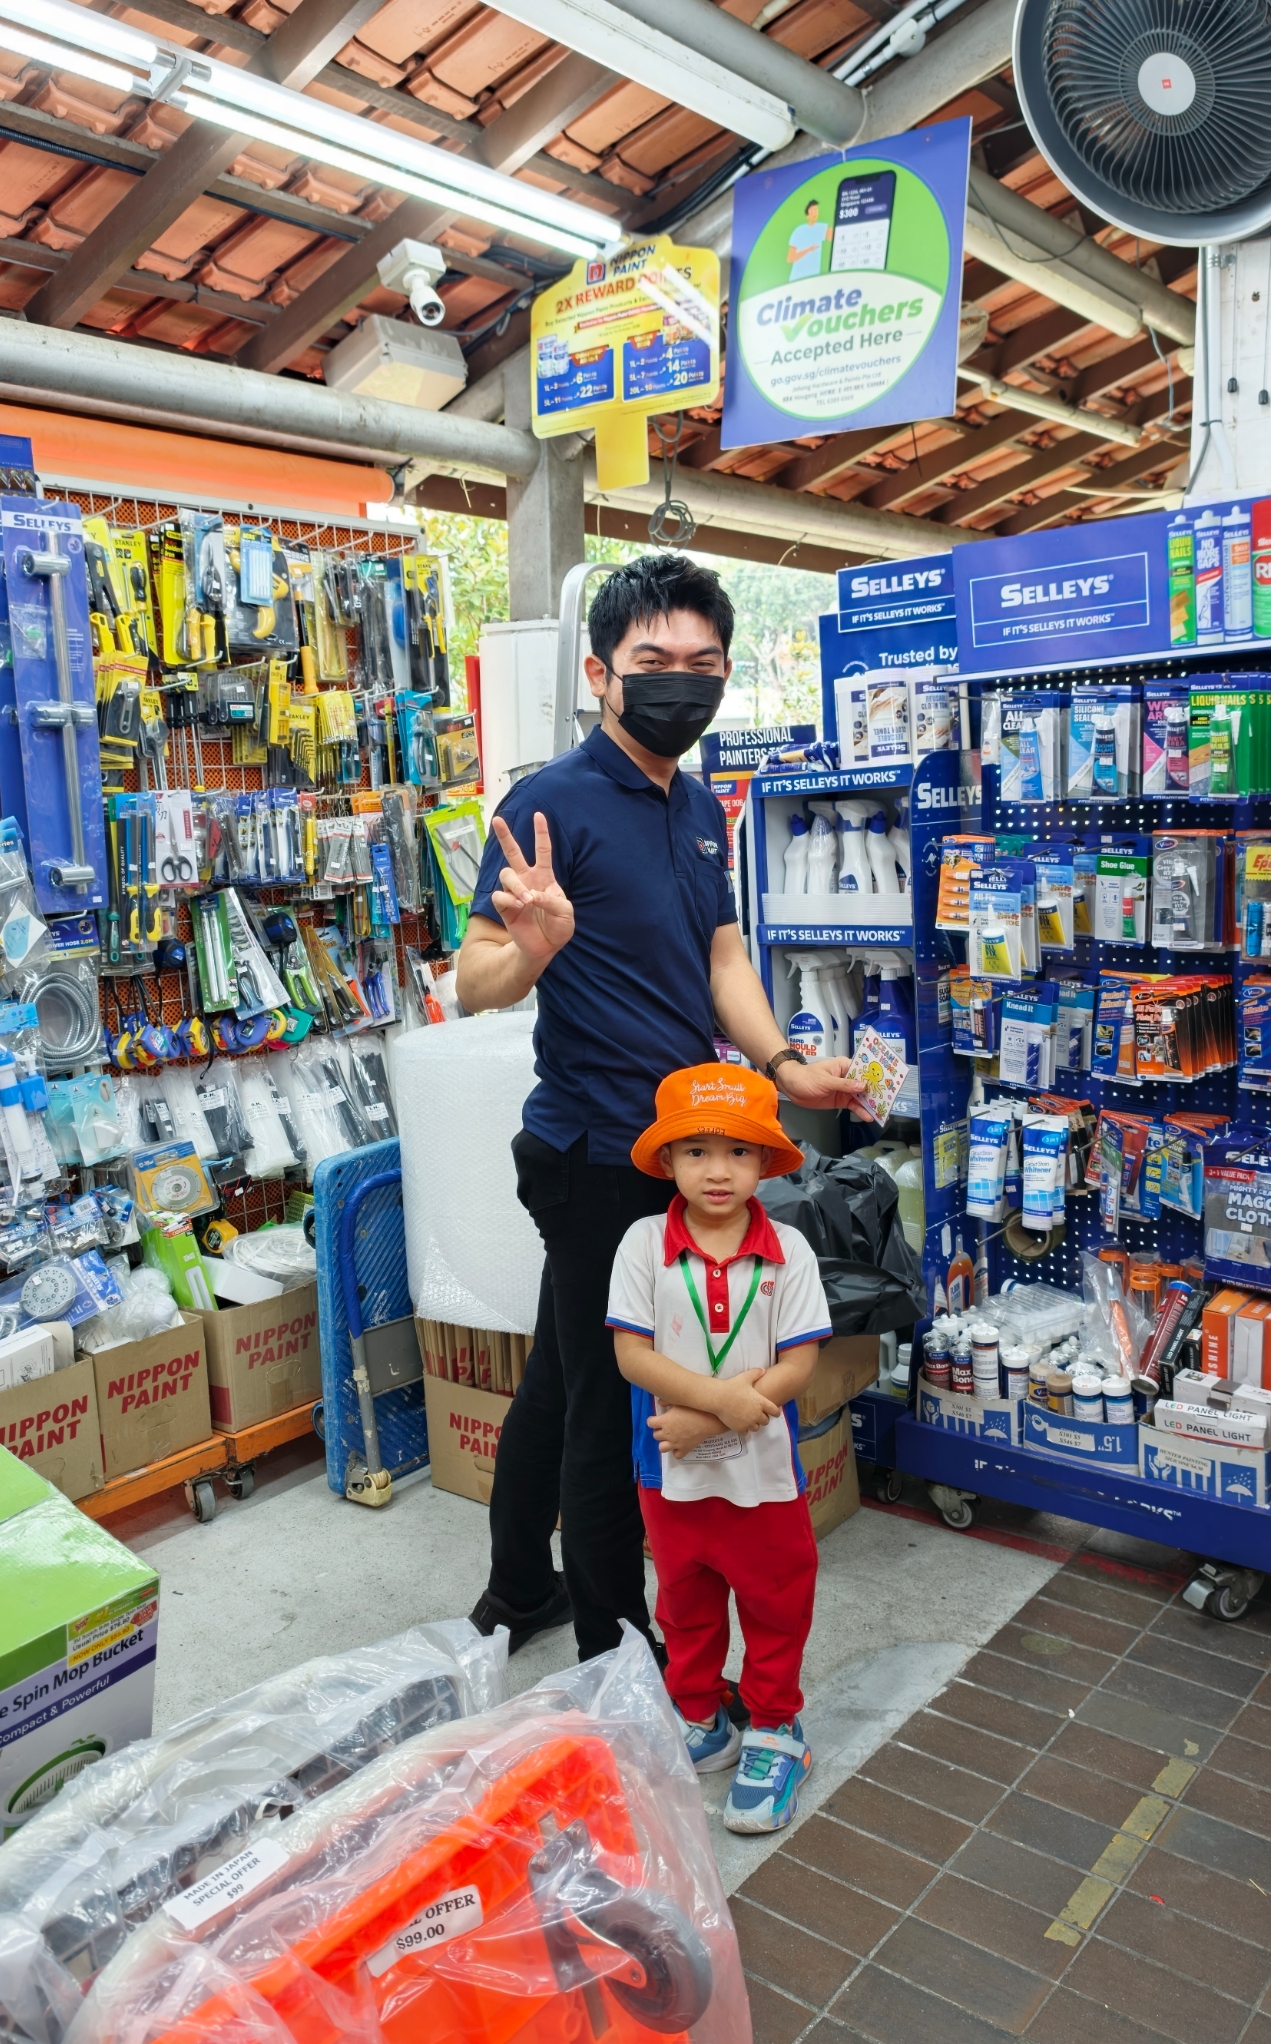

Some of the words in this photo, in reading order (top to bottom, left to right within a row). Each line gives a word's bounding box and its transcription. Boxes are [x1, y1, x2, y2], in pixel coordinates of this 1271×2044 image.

[839, 207, 858, 219] $300
[610, 245, 655, 267] NIPPON
[613, 260, 647, 277] PAINT
[556, 299, 572, 314] 2X
[576, 278, 635, 304] REWARD
[757, 289, 862, 326] Climate
[771, 335, 853, 365] Accepted
[860, 330, 903, 348] Here
[667, 360, 680, 372] 14
[770, 355, 901, 387] go.gov.sg/climatevouchers
[576, 373, 583, 384] 6
[673, 373, 688, 385] 20
[580, 385, 594, 398] 22
[14, 514, 71, 531] SELLEYS
[1170, 536, 1191, 547] LIQUID
[1196, 529, 1220, 538] SELLEYS
[1223, 529, 1249, 539] SELLEYS
[1170, 547, 1192, 559] NAILS
[1201, 538, 1215, 549] NO
[1196, 548, 1220, 560] MORE
[1197, 558, 1220, 570] GAPS
[851, 569, 942, 598] SELLEYS
[1001, 575, 1110, 608] SELLEYS
[852, 615, 859, 624] IF
[860, 613, 873, 622] IT'S
[874, 609, 904, 621] SELLEYS
[905, 608, 912, 617] IT
[913, 603, 942, 616] WORKS
[1003, 627, 1011, 637] IF
[1012, 625, 1028, 636] IT'S
[1029, 619, 1065, 633] SELLEYS
[1066, 618, 1076, 628] IT
[1077, 613, 1111, 627] WORKS
[879, 646, 935, 666] Trusted
[939, 645, 958, 660] by
[720, 726, 794, 747] PROFESSIONAL
[762, 782, 771, 793] IF
[773, 780, 792, 792] IT'S
[794, 776, 838, 790] SELLEYS
[840, 775, 850, 786] IT
[851, 771, 896, 786] WORKS
[917, 782, 982, 809] SELLEYS
[1101, 861, 1117, 870] Shoe
[1119, 862, 1135, 870] Glue
[974, 882, 1007, 890] SELLEYS
[768, 930, 777, 940] IF
[779, 930, 797, 940] IT'S
[798, 929, 843, 941] SELLEYS
[845, 930, 854, 941] IT
[854, 930, 900, 941] WORKS
[1006, 1002, 1025, 1012] Knead
[790, 1043, 817, 1052] MOULD
[873, 1037, 899, 1067] OCEANS
[690, 1080, 716, 1095] Start
[717, 1078, 745, 1092] Small
[691, 1094, 725, 1107] Dream
[726, 1093, 747, 1107] Big
[970, 1134, 998, 1144] SELLEYS
[1024, 1144, 1056, 1154] SELLEYS
[1220, 1170, 1235, 1178] VALUE
[1236, 1172, 1250, 1180] PACK
[1229, 1185, 1257, 1194] MIGHTY
[236, 1311, 316, 1355] NIPPON
[248, 1332, 311, 1369] PAINT
[107, 1350, 199, 1399] NIPPON
[952, 1367, 971, 1376] Max
[121, 1372, 193, 1414] PAINT
[1165, 1402, 1183, 1410] LED
[1187, 1405, 1219, 1417] PANEL
[1224, 1411, 1253, 1422] LIGHT
[1164, 1420, 1183, 1430] LED
[1186, 1423, 1219, 1437] PANEL
[1222, 1431, 1251, 1442] LIGHT
[1160, 1448, 1181, 1459] HUNTER
[1183, 1456, 1208, 1467] PAINTING
[73, 1639, 91, 1651] Usual
[92, 1629, 108, 1642] Price
[82, 1629, 98, 1640] Scotch
[73, 1649, 90, 1661] NOW
[91, 1638, 108, 1653] ONLY
[13, 1684, 49, 1713] Spin
[53, 1663, 89, 1690] Mop
[93, 1629, 144, 1668] Bucket
[50, 1705, 58, 1717] &
[62, 1675, 110, 1709] Powerful
[183, 1881, 211, 1900] MADE
[212, 1872, 224, 1882] IN
[225, 1851, 253, 1873] JAPAN
[193, 1880, 232, 1906] SPECIAL
[231, 1857, 261, 1880] OFFER
[227, 1883, 244, 1899] $99
[425, 1893, 475, 1919] OFFER
[396, 1923, 445, 1950] $99.00
